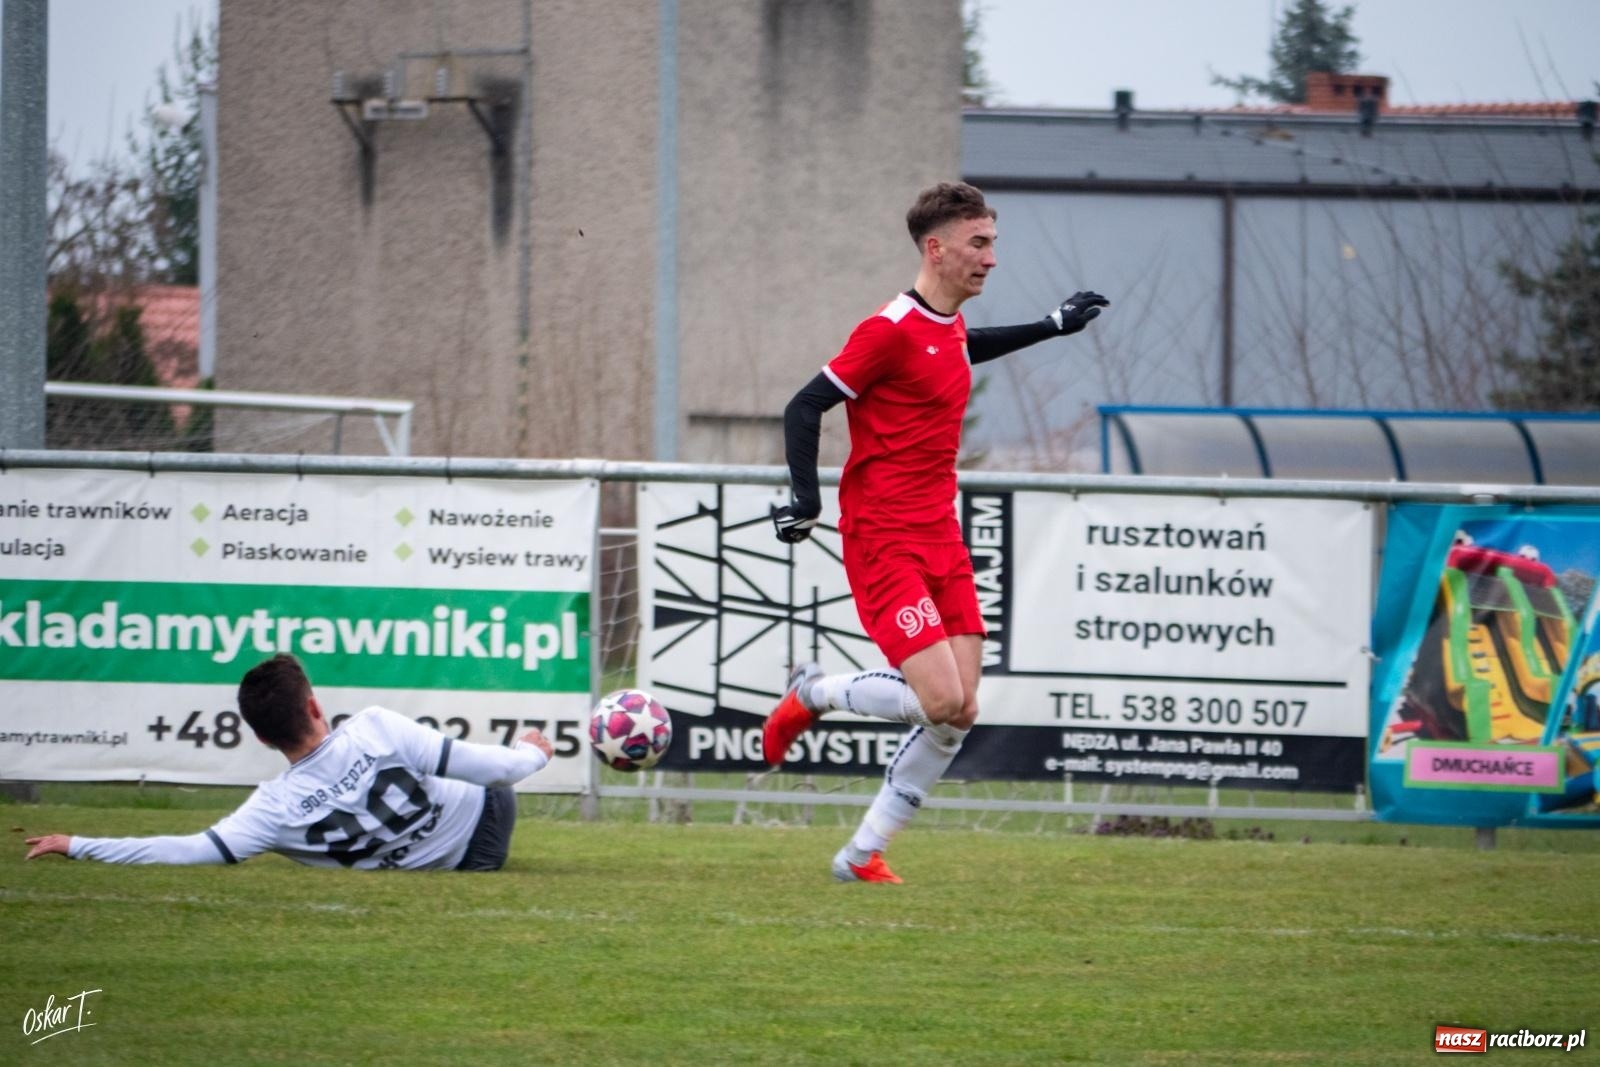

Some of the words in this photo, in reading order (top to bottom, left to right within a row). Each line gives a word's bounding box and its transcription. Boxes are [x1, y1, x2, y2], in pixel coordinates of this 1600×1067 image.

[47, 502, 172, 520] trawników
[222, 504, 309, 525] Aeracja
[428, 508, 554, 528] Nawożenie
[1086, 522, 1266, 552] rusztowań
[222, 541, 367, 562] Piaskowanie
[428, 546, 517, 569] Wysiew
[525, 551, 587, 571] trawy
[1077, 564, 1084, 591] i
[1095, 566, 1273, 598] szalunków
[896, 596, 941, 638] 99
[1075, 615, 1274, 651] stropowych
[1049, 692, 1111, 721] TEL.
[1122, 695, 1178, 724] 538
[1187, 698, 1243, 726] 300
[1252, 700, 1308, 728] 507
[147, 710, 242, 749] +48
[690, 727, 764, 761] PNG
[784, 730, 910, 765] SYSTE
[1121, 735, 1143, 751] ul.
[1146, 736, 1188, 753] Jana
[1432, 756, 1534, 776] DMUCHAŃCE
